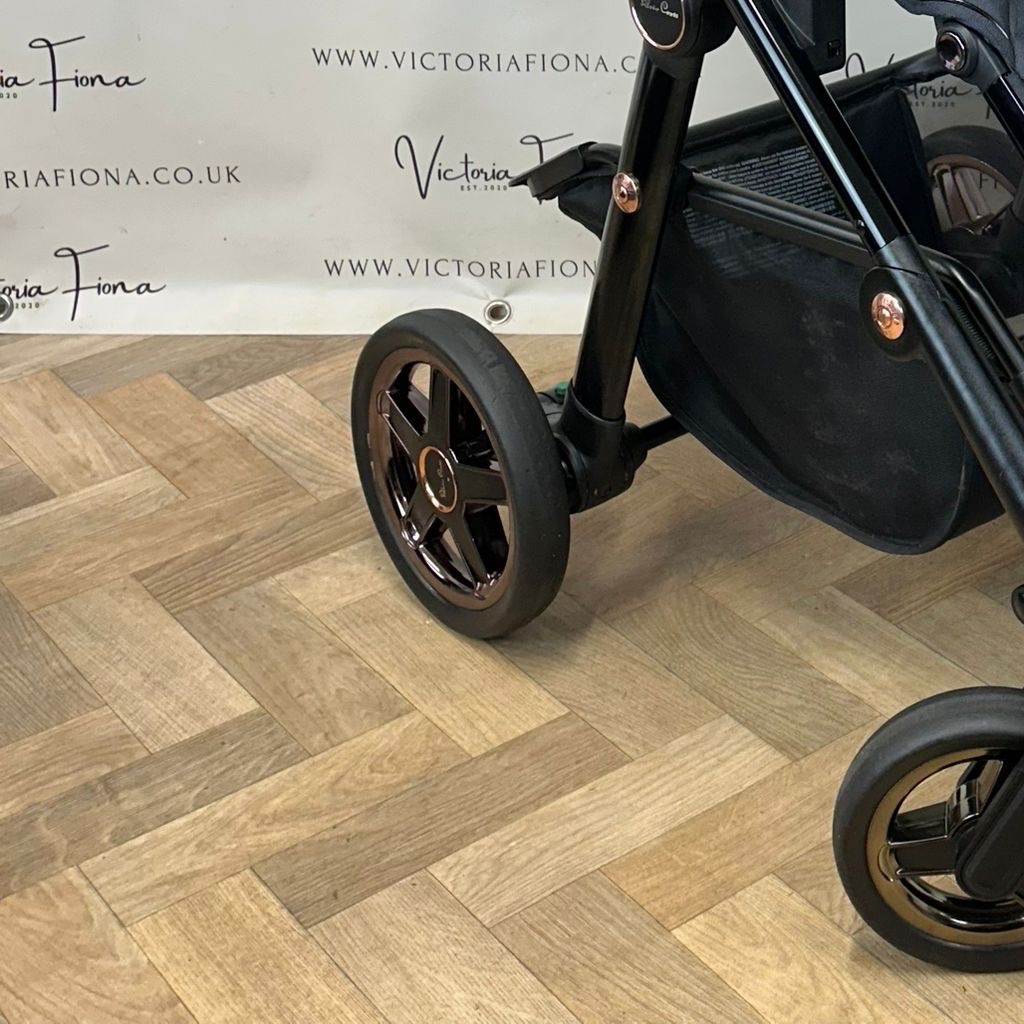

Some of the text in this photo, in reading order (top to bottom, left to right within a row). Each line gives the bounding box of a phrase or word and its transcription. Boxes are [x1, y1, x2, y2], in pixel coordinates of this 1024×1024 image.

[28, 36, 147, 112] Fiona
[5, 165, 241, 189] RIAFIONA.CO.UK
[395, 135, 516, 199] Victoria
[54, 245, 167, 321] Fiona
